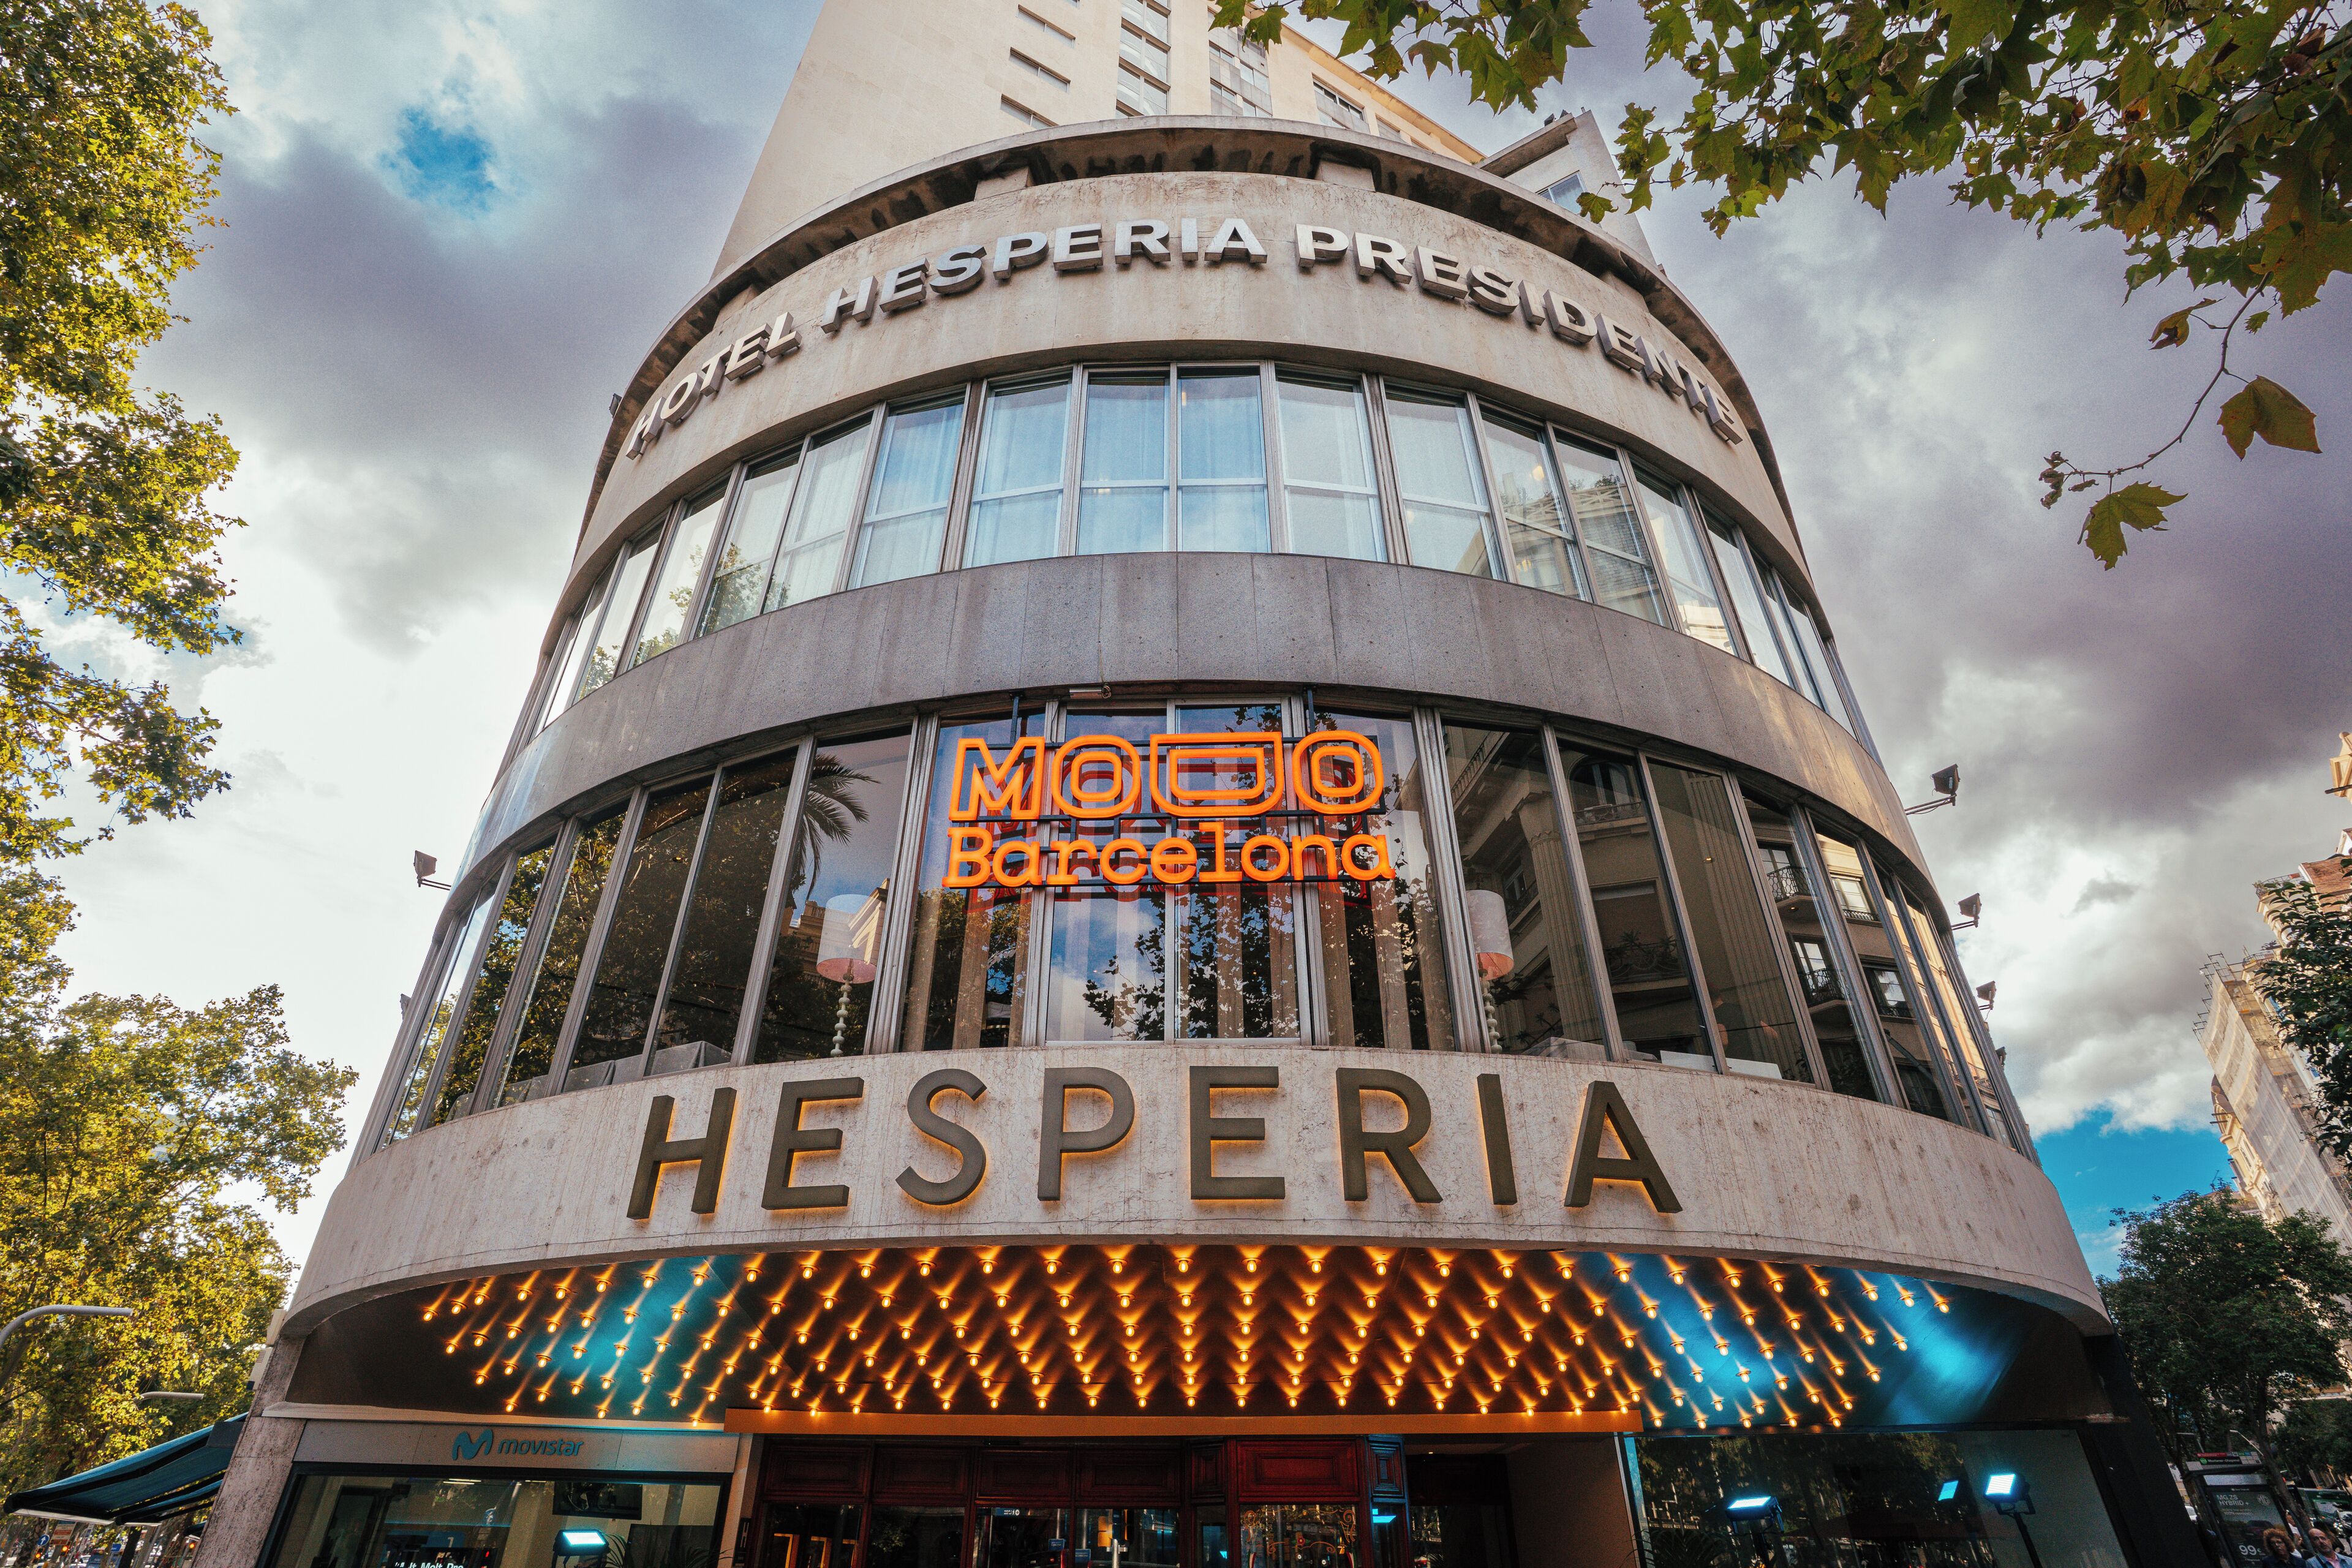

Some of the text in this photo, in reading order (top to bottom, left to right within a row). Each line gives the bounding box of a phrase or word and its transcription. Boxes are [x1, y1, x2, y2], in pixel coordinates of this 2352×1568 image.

[625, 217, 1744, 459] HOTEL HESPERIA PRESIDENTE
[942, 822, 1395, 888] Barcelona
[627, 1065, 1683, 1219] HESPERIA
[497, 1438, 584, 1457] movistar
